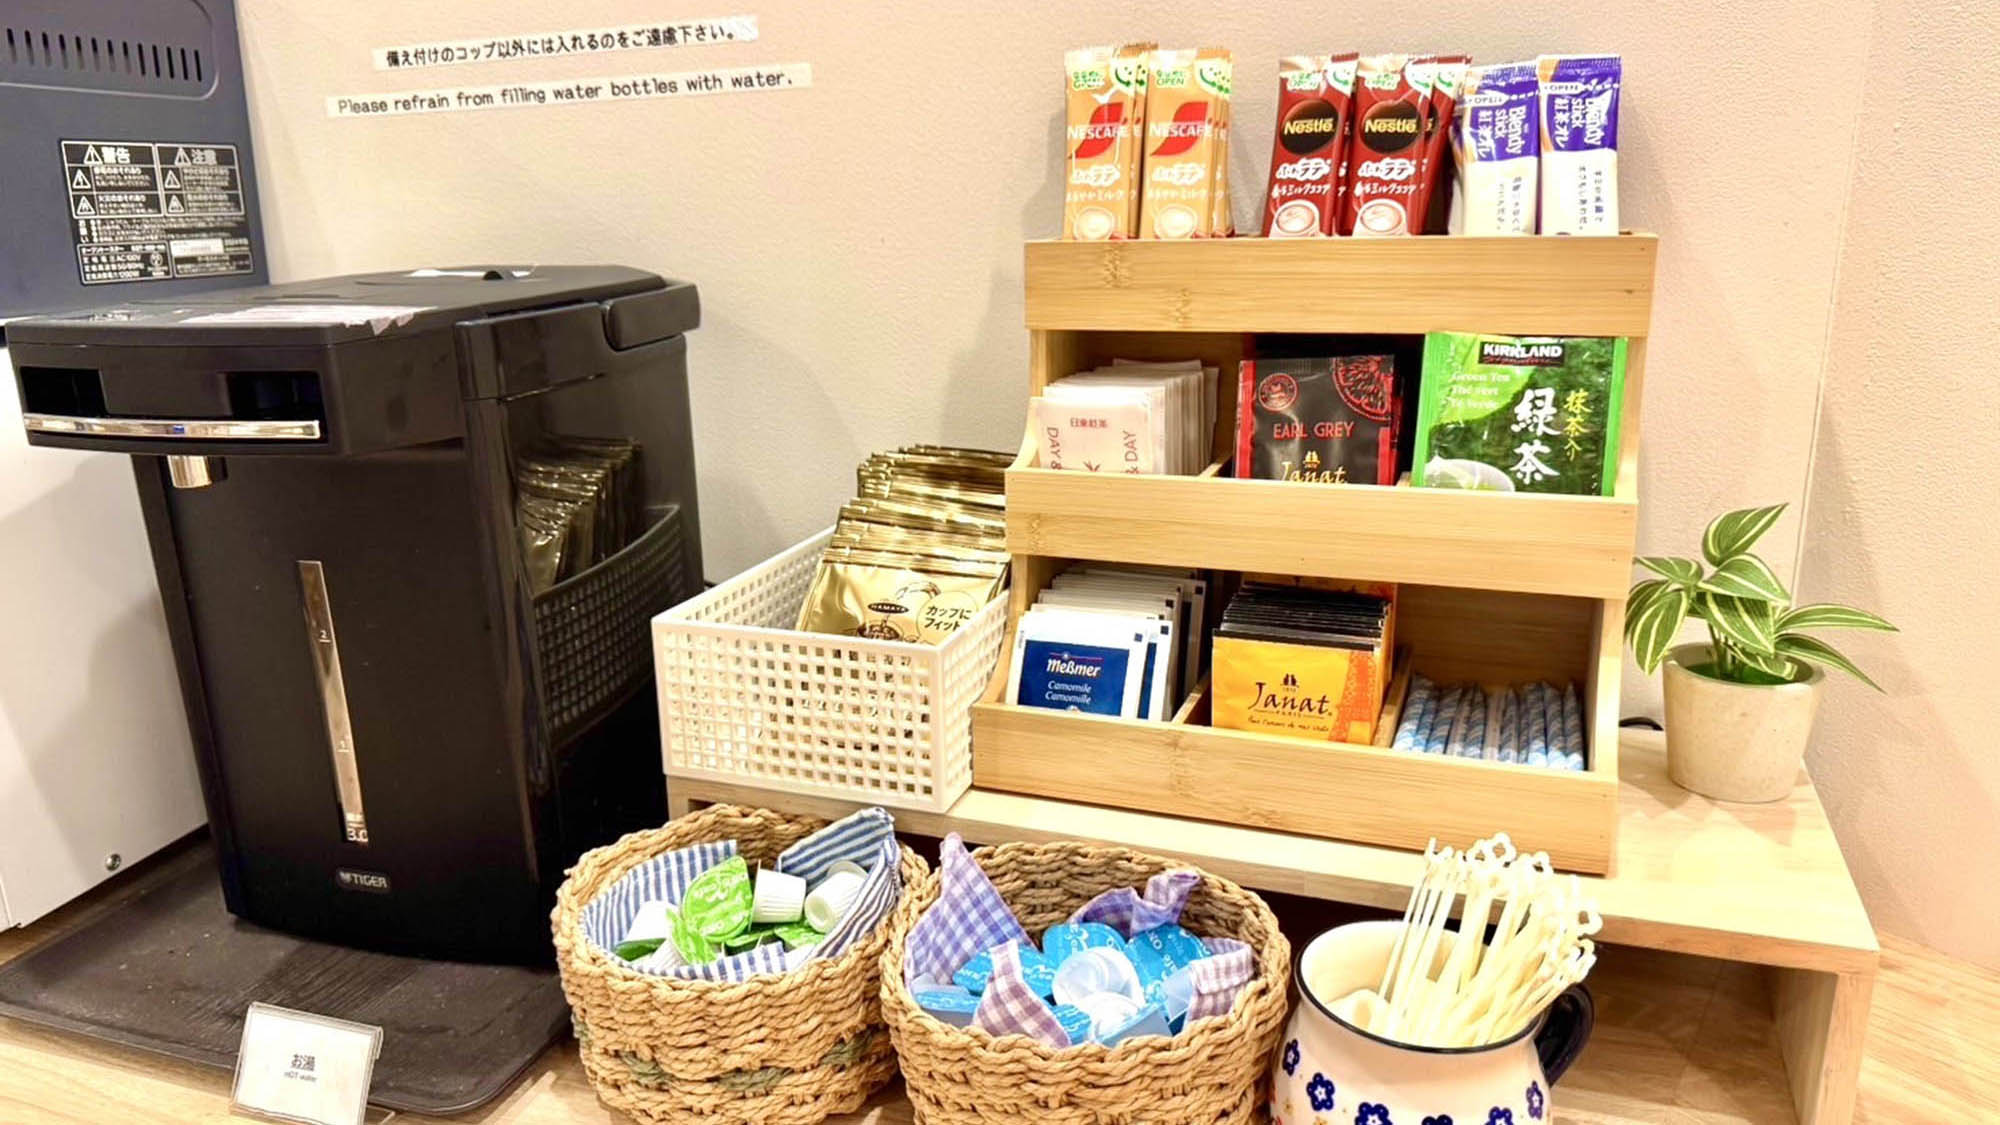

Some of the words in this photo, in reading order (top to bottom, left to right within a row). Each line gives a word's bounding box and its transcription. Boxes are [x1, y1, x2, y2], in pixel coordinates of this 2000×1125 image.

[385, 25, 735, 67] 備え付けのコップ以外には入れるのをご遠慮下さい。
[338, 98, 388, 115] Please
[394, 94, 450, 111] refrain
[456, 92, 494, 107] from
[500, 87, 546, 105] filling
[552, 85, 602, 100] water
[610, 77, 678, 98] bottles
[686, 74, 722, 92] with
[731, 70, 793, 88] water.
[1484, 344, 1562, 358] KIRKLAND
[1273, 423, 1307, 439] EARL
[1313, 421, 1354, 438] GREY
[1510, 387, 1562, 485] 緑茶
[925, 605, 972, 620] カップに
[1046, 657, 1101, 677] Meßmer
[1047, 680, 1093, 693] Camomile
[1044, 691, 1092, 705] Camomille
[352, 873, 387, 888] TIGER
